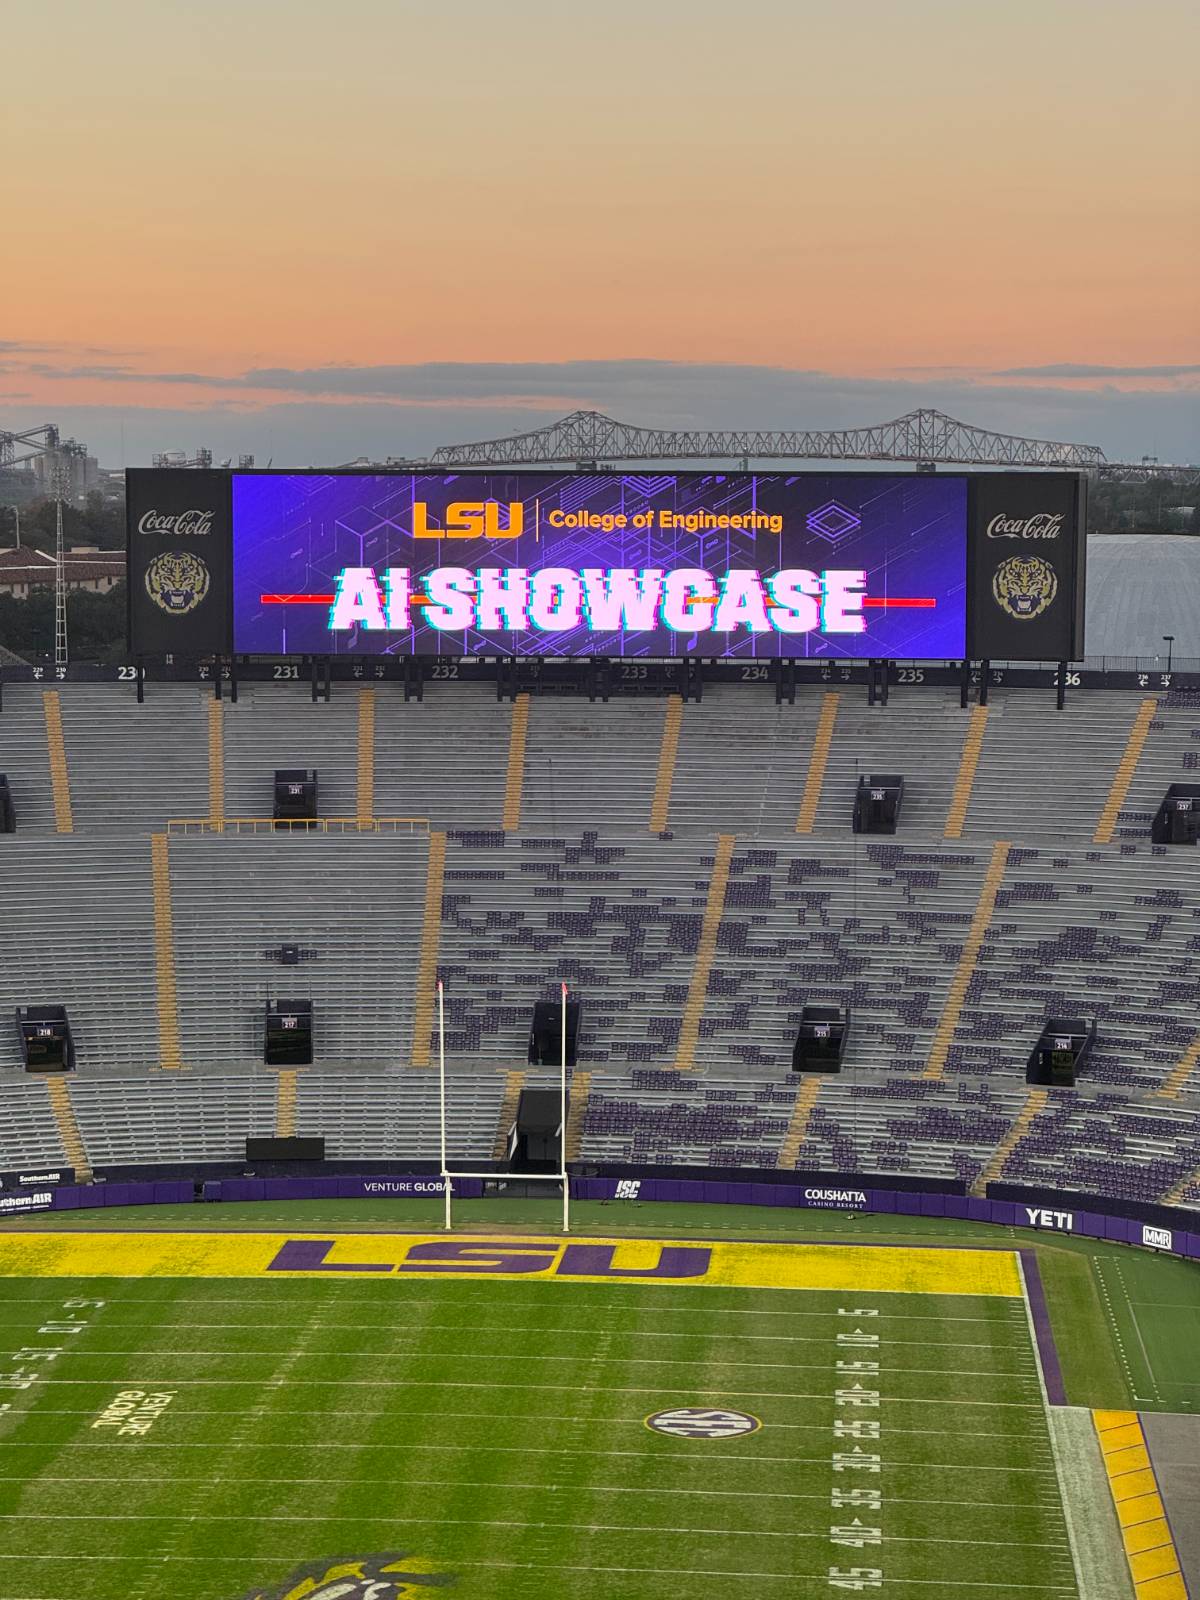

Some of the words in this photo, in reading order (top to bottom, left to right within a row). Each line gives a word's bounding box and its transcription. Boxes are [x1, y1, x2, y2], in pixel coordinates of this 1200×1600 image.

[138, 509, 216, 535] Coca-Cola
[412, 502, 524, 539] LSU
[549, 510, 628, 532] College
[632, 510, 654, 528] of
[659, 510, 784, 533] Engineering
[986, 513, 1066, 539] Coca-Cola
[328, 567, 411, 632] AI
[420, 567, 868, 633] SHOWCASE
[273, 665, 300, 679] 231
[431, 665, 459, 679] 232
[621, 665, 648, 679] 233
[741, 666, 769, 680] 234
[897, 669, 925, 683] 235
[364, 1182, 413, 1192] VENTURE
[804, 1188, 867, 1202] COUSHATTA
[1025, 1207, 1073, 1230] YETI
[1144, 1229, 1171, 1247] MMR
[265, 1240, 712, 1278] LSU
[837, 1308, 880, 1316] 5
[37, 1320, 88, 1334] 10
[836, 1333, 880, 1348] 10
[12, 1347, 64, 1361] 15
[835, 1360, 880, 1376] 15
[835, 1389, 880, 1407] 20
[90, 1390, 147, 1429] GLOBAL
[117, 1390, 179, 1436] VENTURE
[834, 1420, 881, 1439] 25
[832, 1452, 881, 1473] 30
[831, 1487, 882, 1510] 35
[830, 1525, 883, 1548] 40
[828, 1566, 884, 1591] 45
